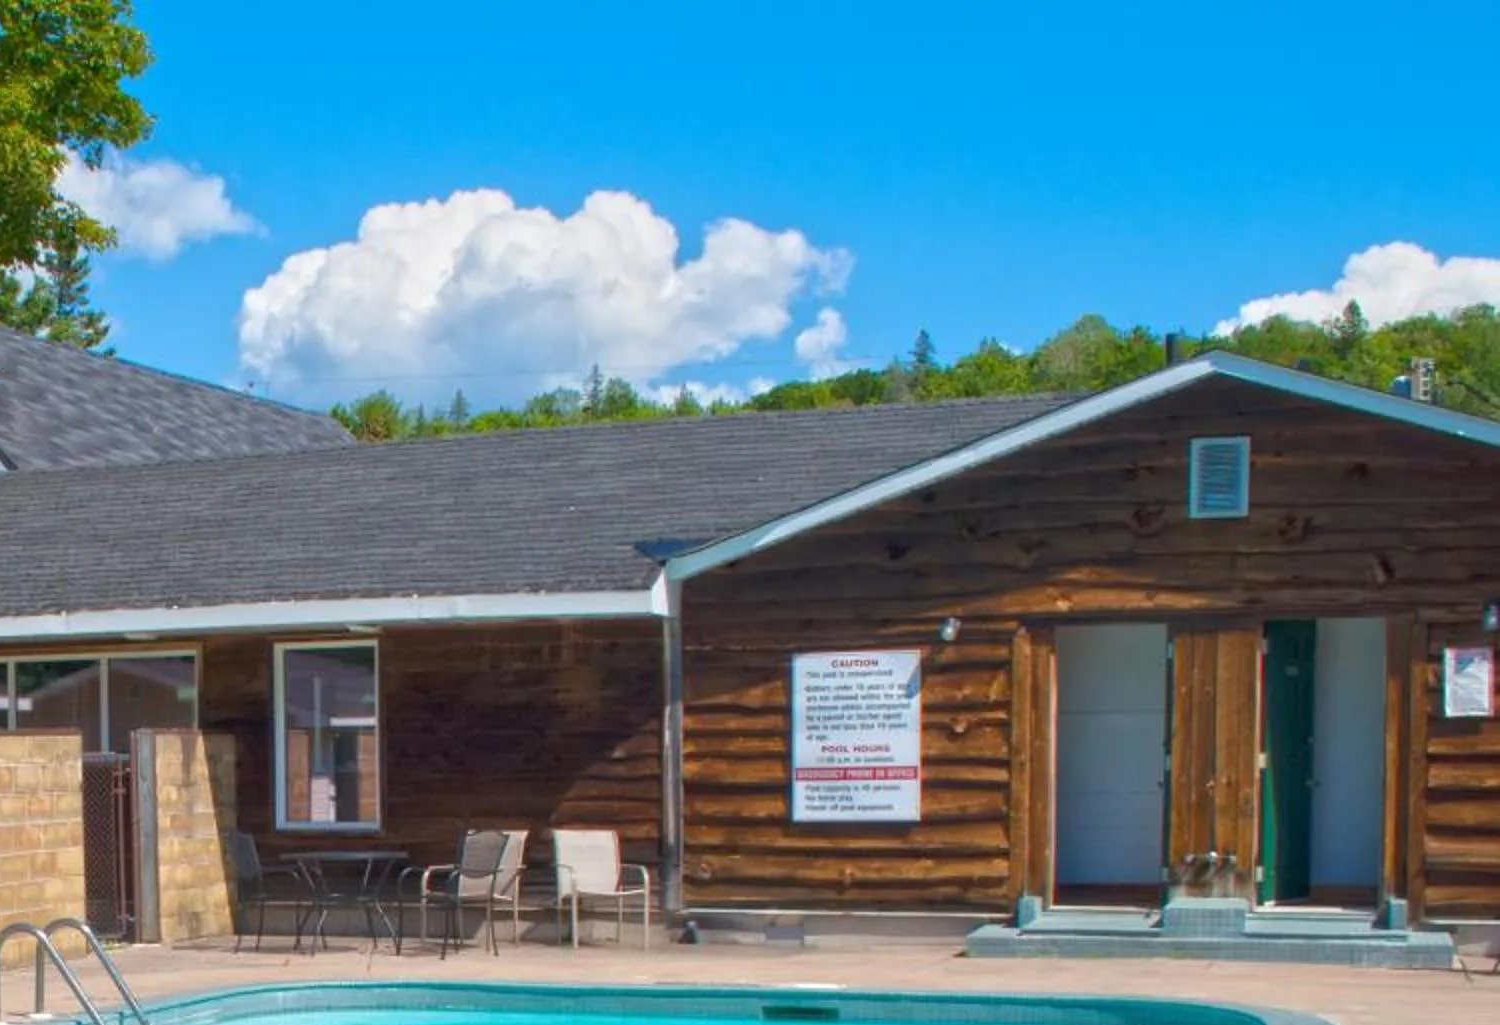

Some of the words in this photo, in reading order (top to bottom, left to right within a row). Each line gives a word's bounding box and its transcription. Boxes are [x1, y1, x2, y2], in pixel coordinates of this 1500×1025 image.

[830, 658, 880, 669] CAUTION
[821, 744, 850, 753] POOL
[853, 743, 891, 753] HOURS
